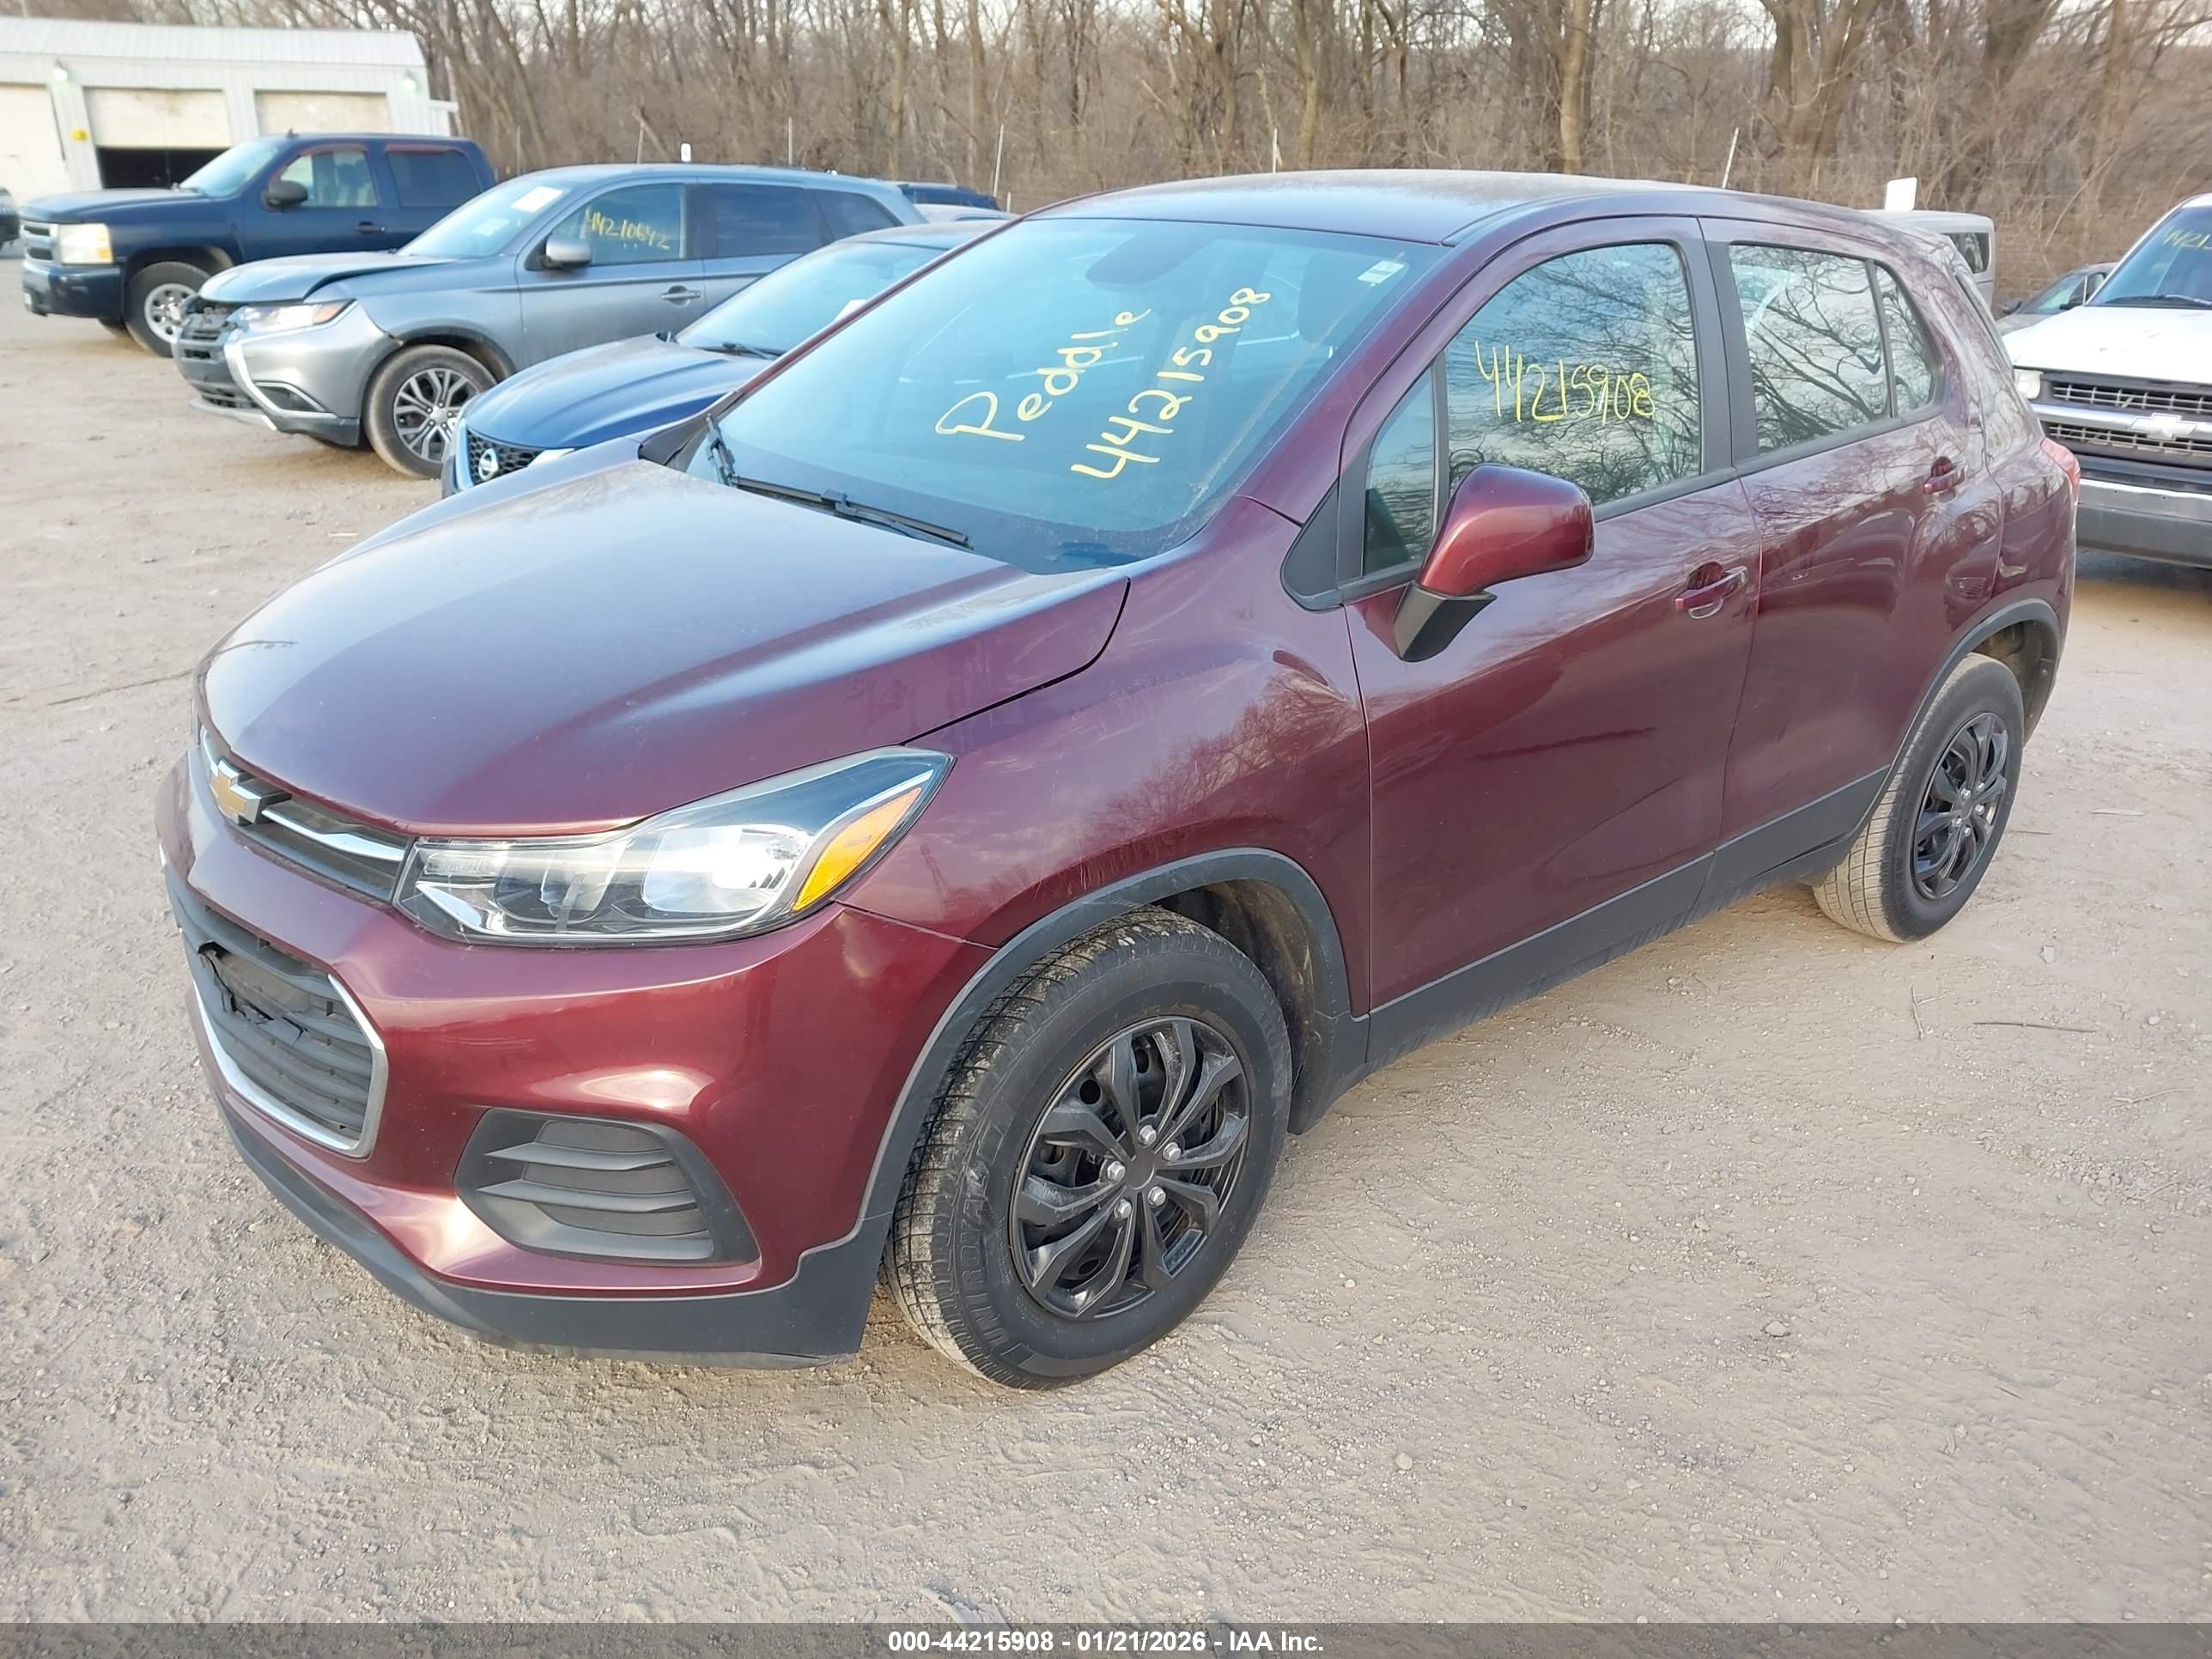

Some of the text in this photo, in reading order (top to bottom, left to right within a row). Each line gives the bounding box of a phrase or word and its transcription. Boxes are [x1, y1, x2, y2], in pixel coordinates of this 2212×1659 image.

[934, 307, 1152, 441] Peddle
[1070, 287, 1271, 478] 44215908
[1474, 340, 1656, 426] 44215908
